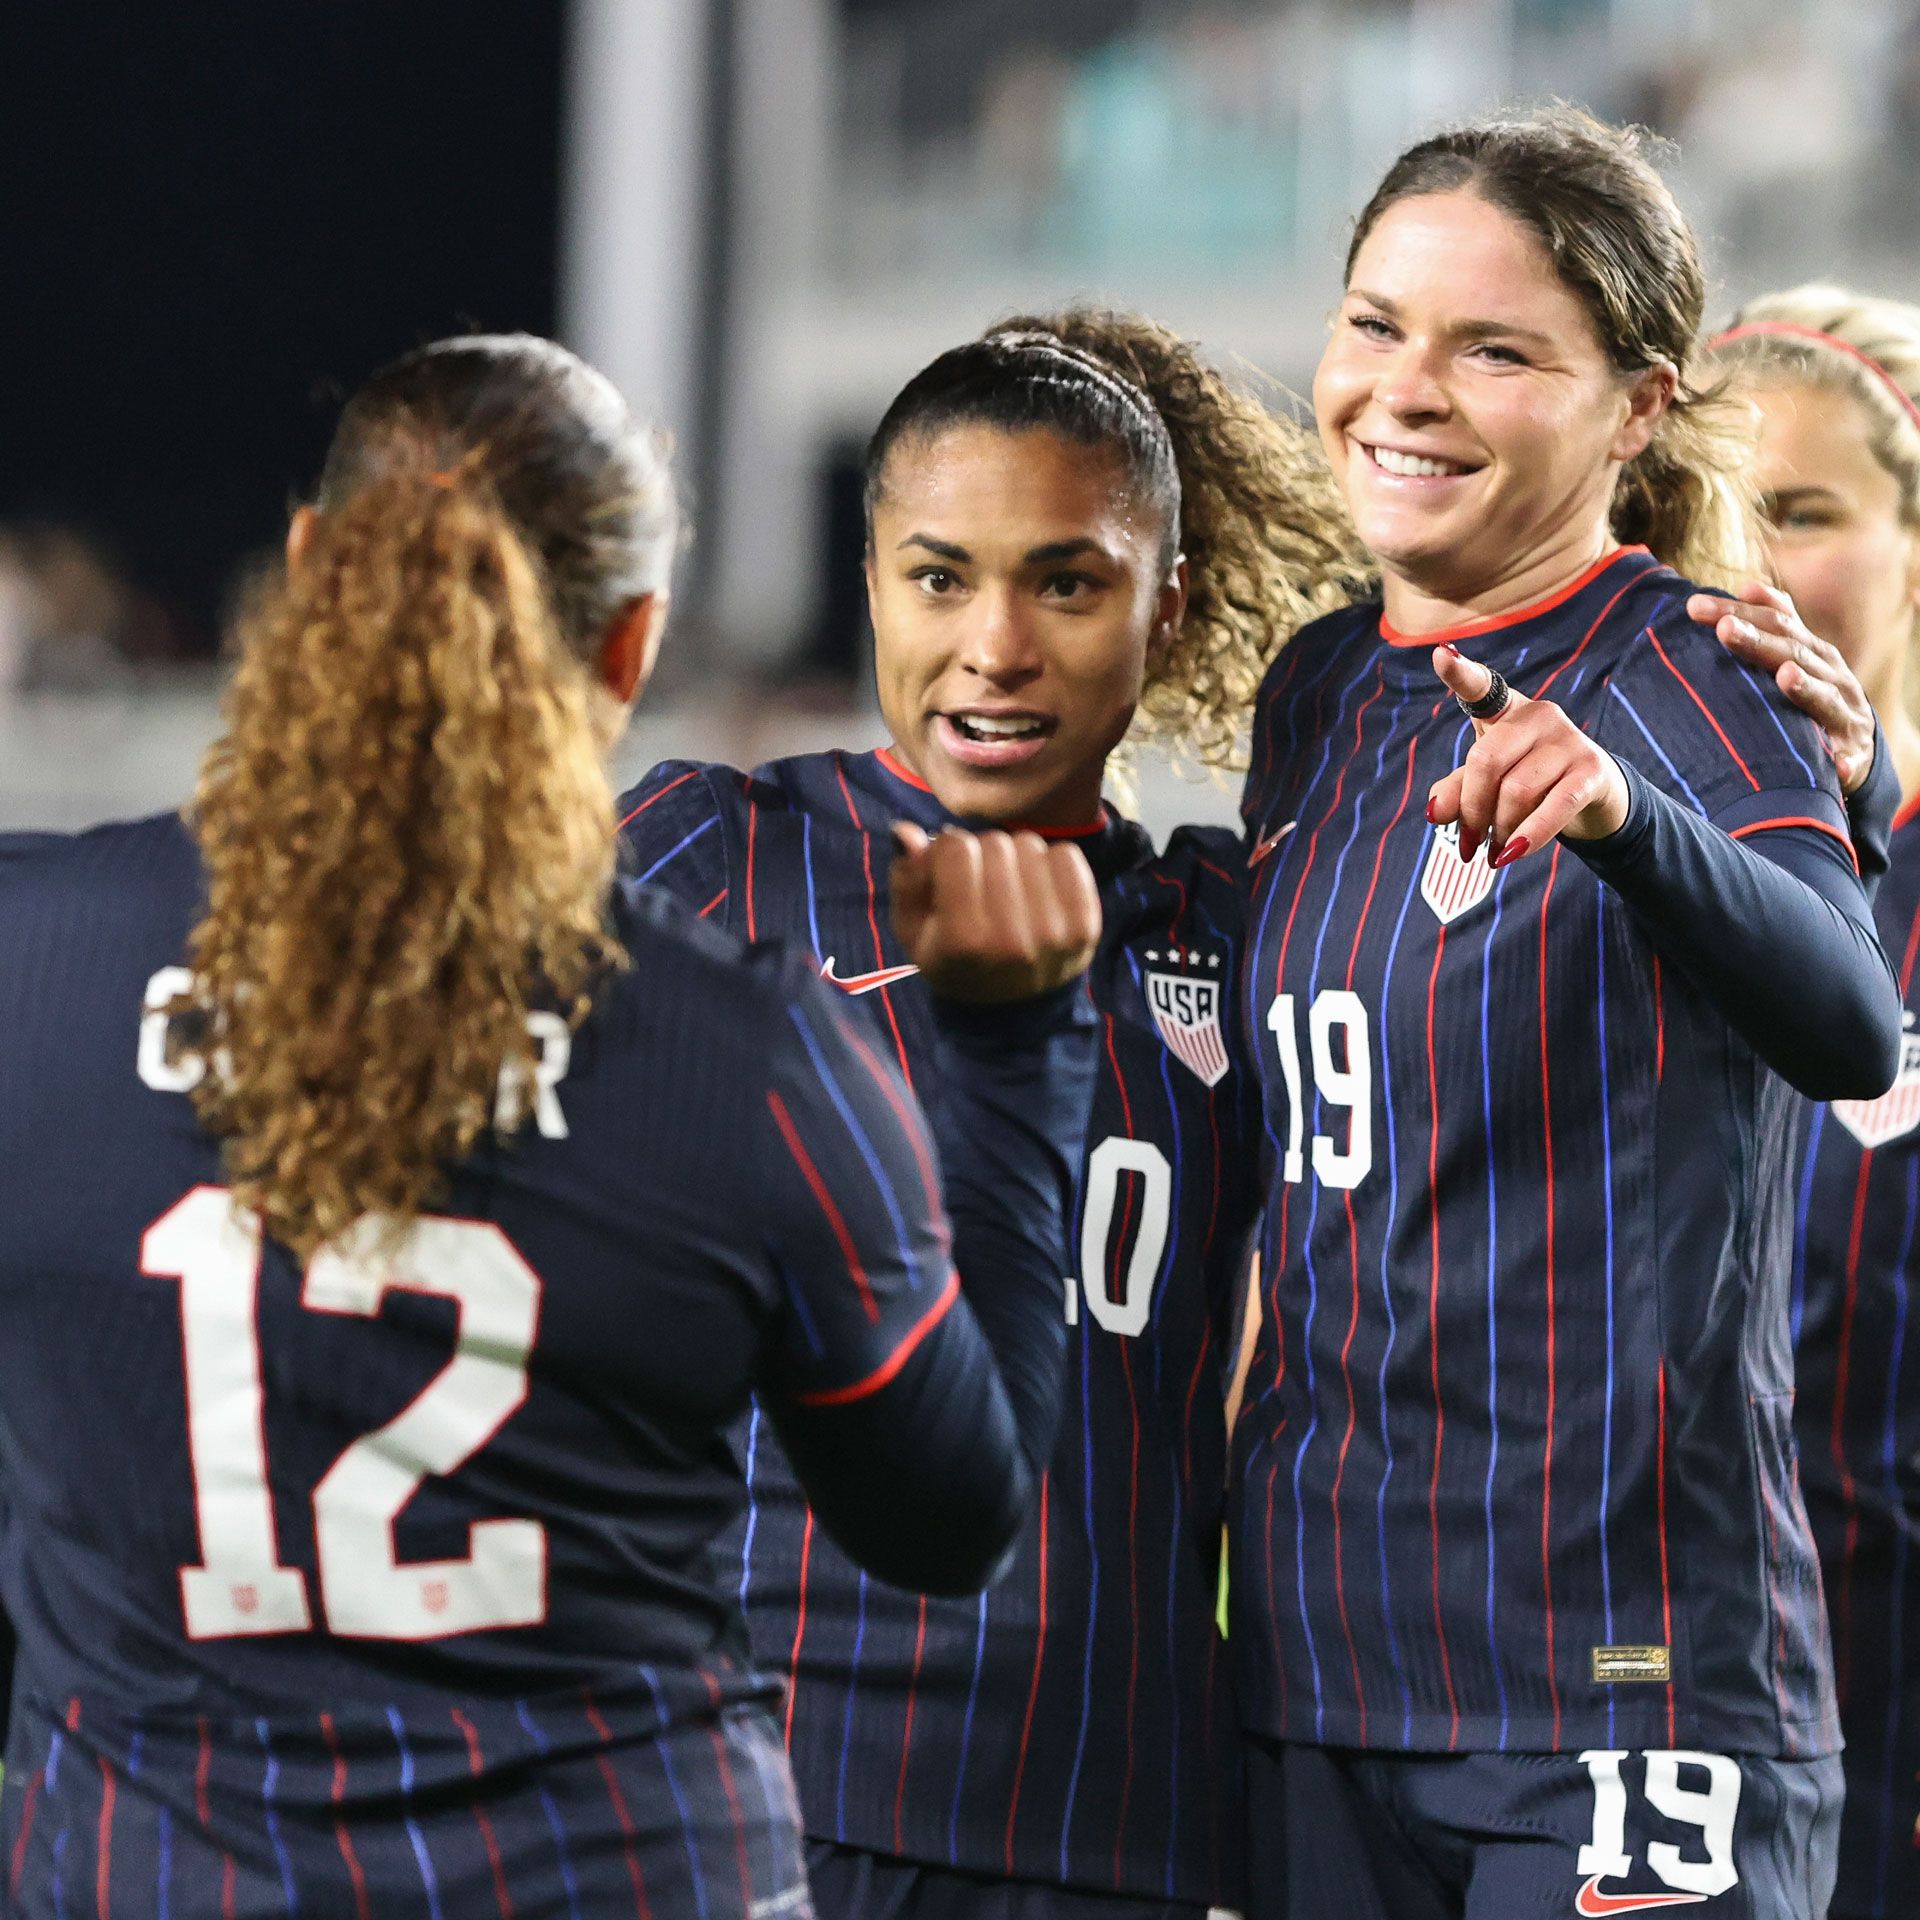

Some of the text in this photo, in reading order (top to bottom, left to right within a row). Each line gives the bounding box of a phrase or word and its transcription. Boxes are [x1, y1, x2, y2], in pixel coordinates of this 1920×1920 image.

[1153, 980, 1212, 1025] USA
[1267, 989, 1372, 1190] 19
[1064, 1135, 1172, 1337] 0
[138, 1184, 548, 1642] 12
[1576, 1750, 1742, 1896] 19
